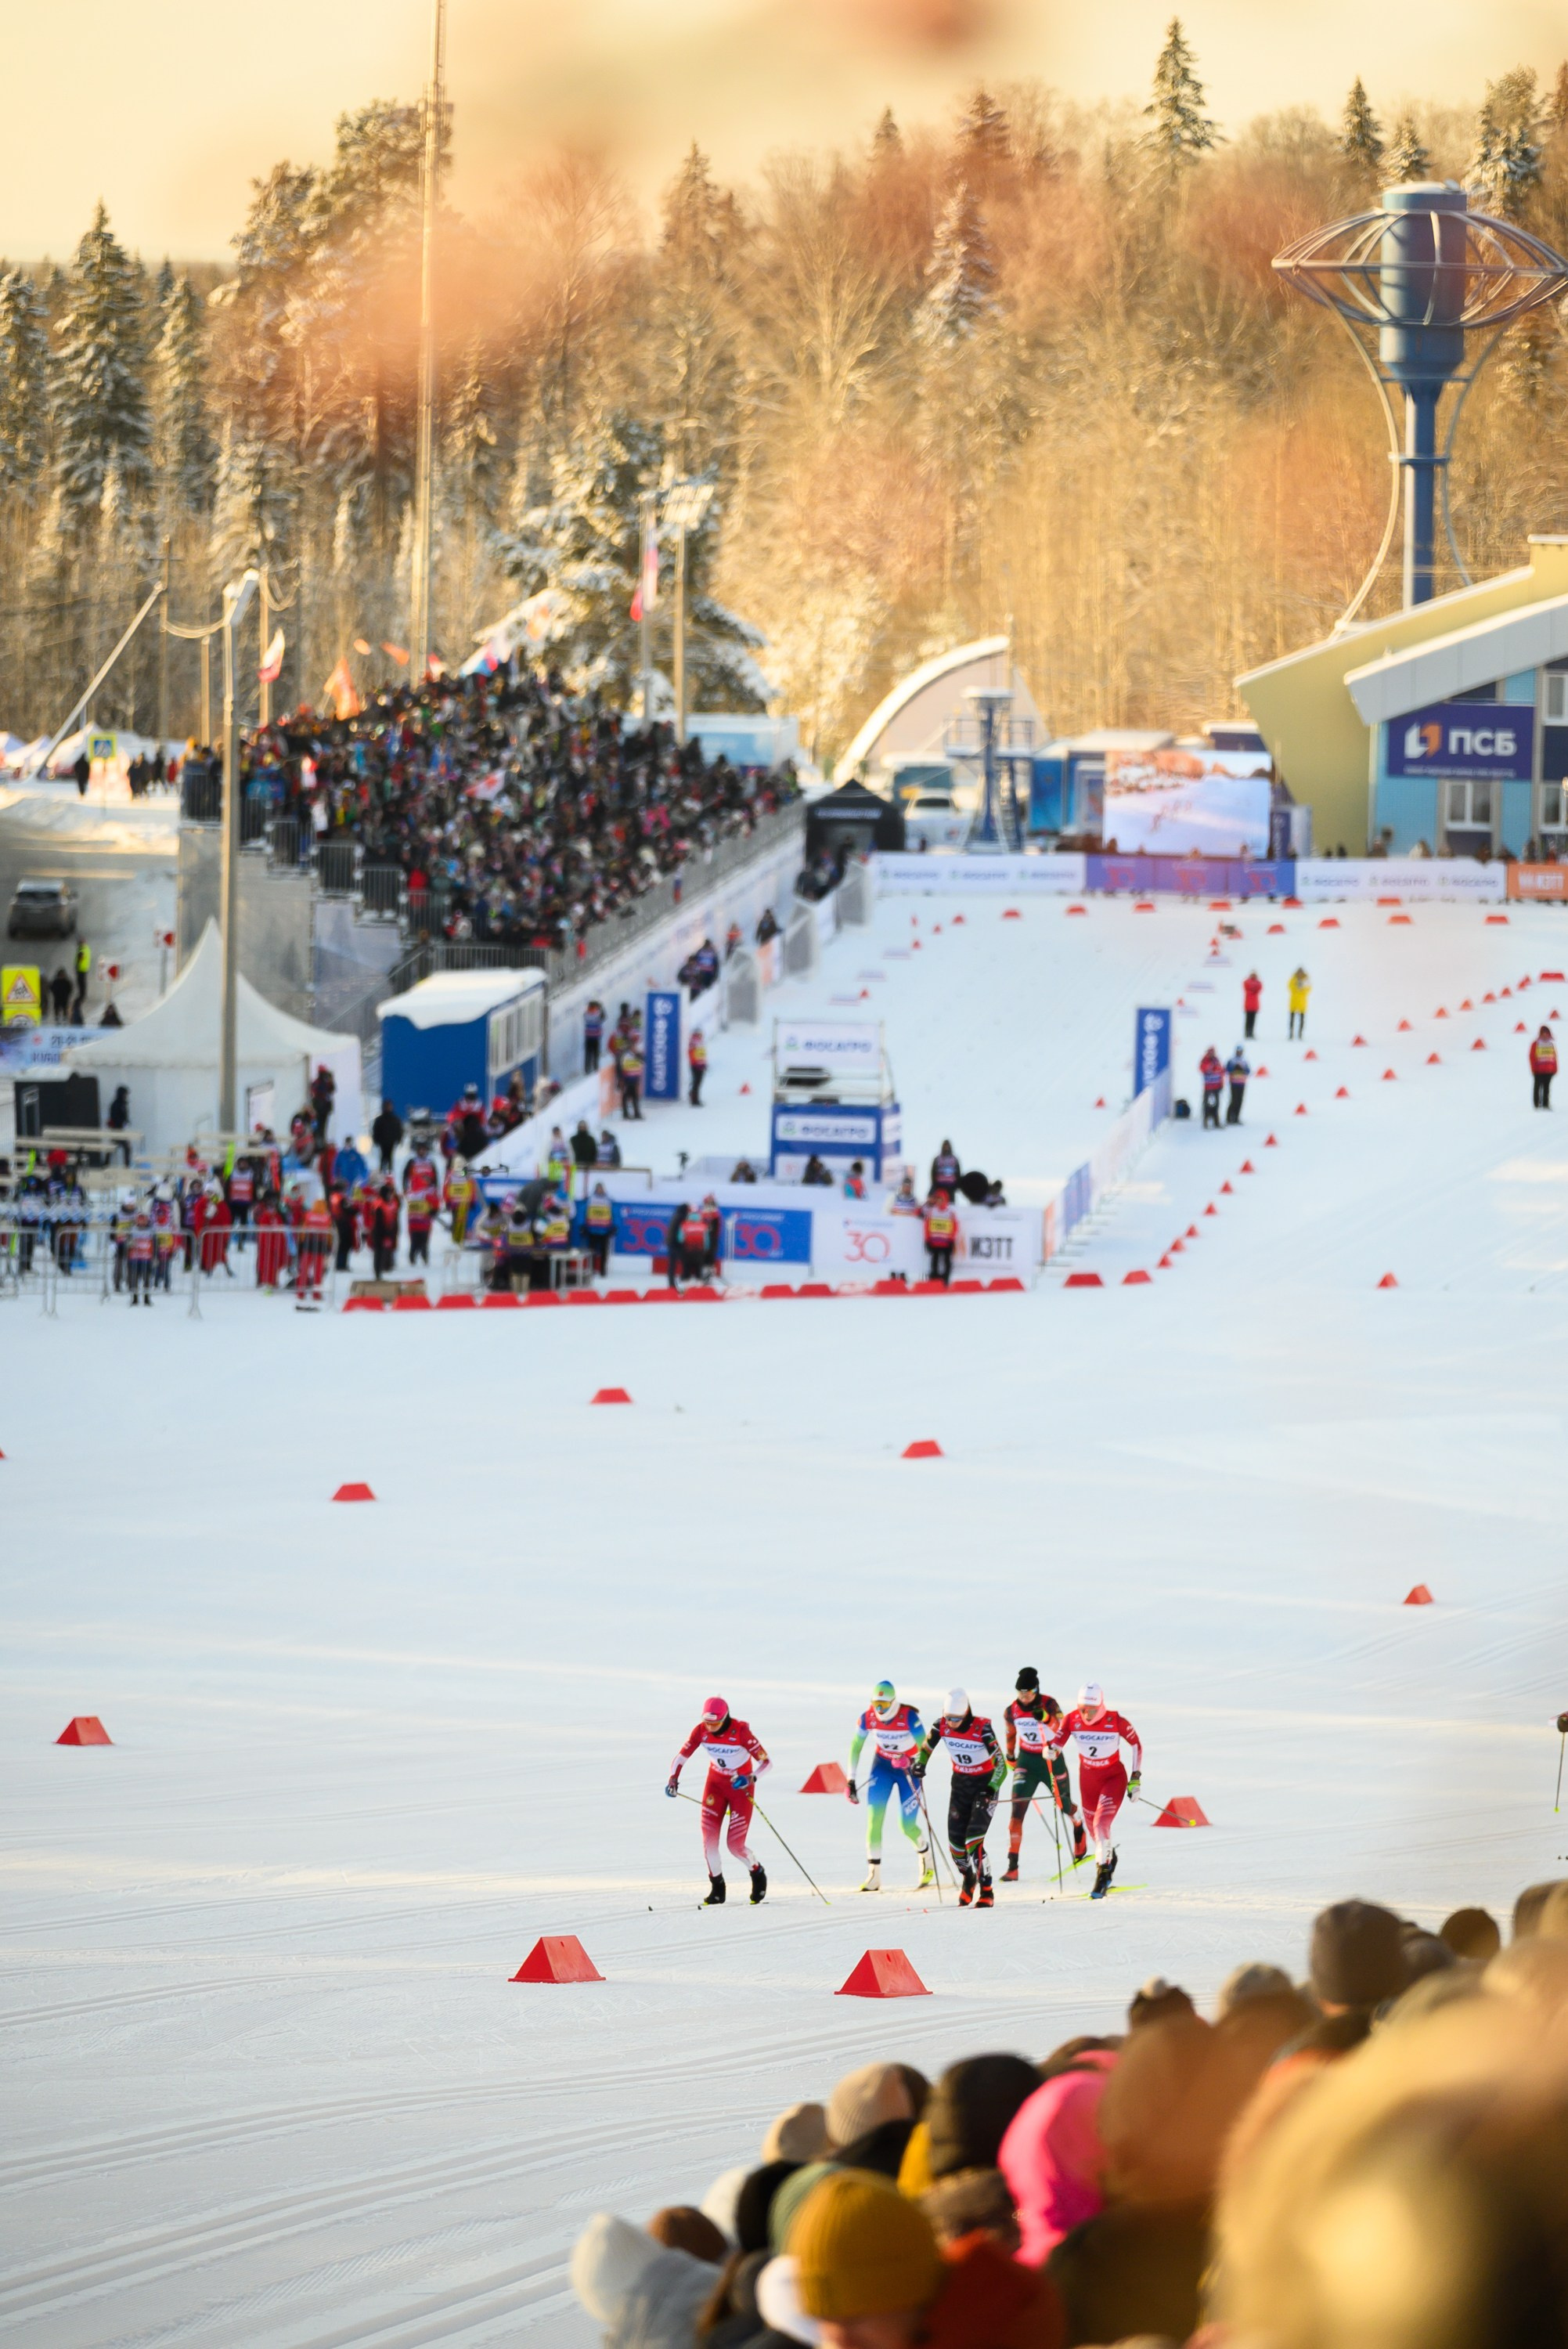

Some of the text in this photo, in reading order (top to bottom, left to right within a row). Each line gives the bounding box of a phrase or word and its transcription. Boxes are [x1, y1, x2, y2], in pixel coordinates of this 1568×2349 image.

[1449, 727, 1517, 756] ПСБ
[804, 1040, 872, 1052] ФОСАГРО
[623, 1218, 669, 1253] 30
[734, 1223, 781, 1257] 30
[844, 1230, 890, 1264] 30
[954, 1753, 972, 1765] 19
[1088, 1746, 1098, 1758] 2
